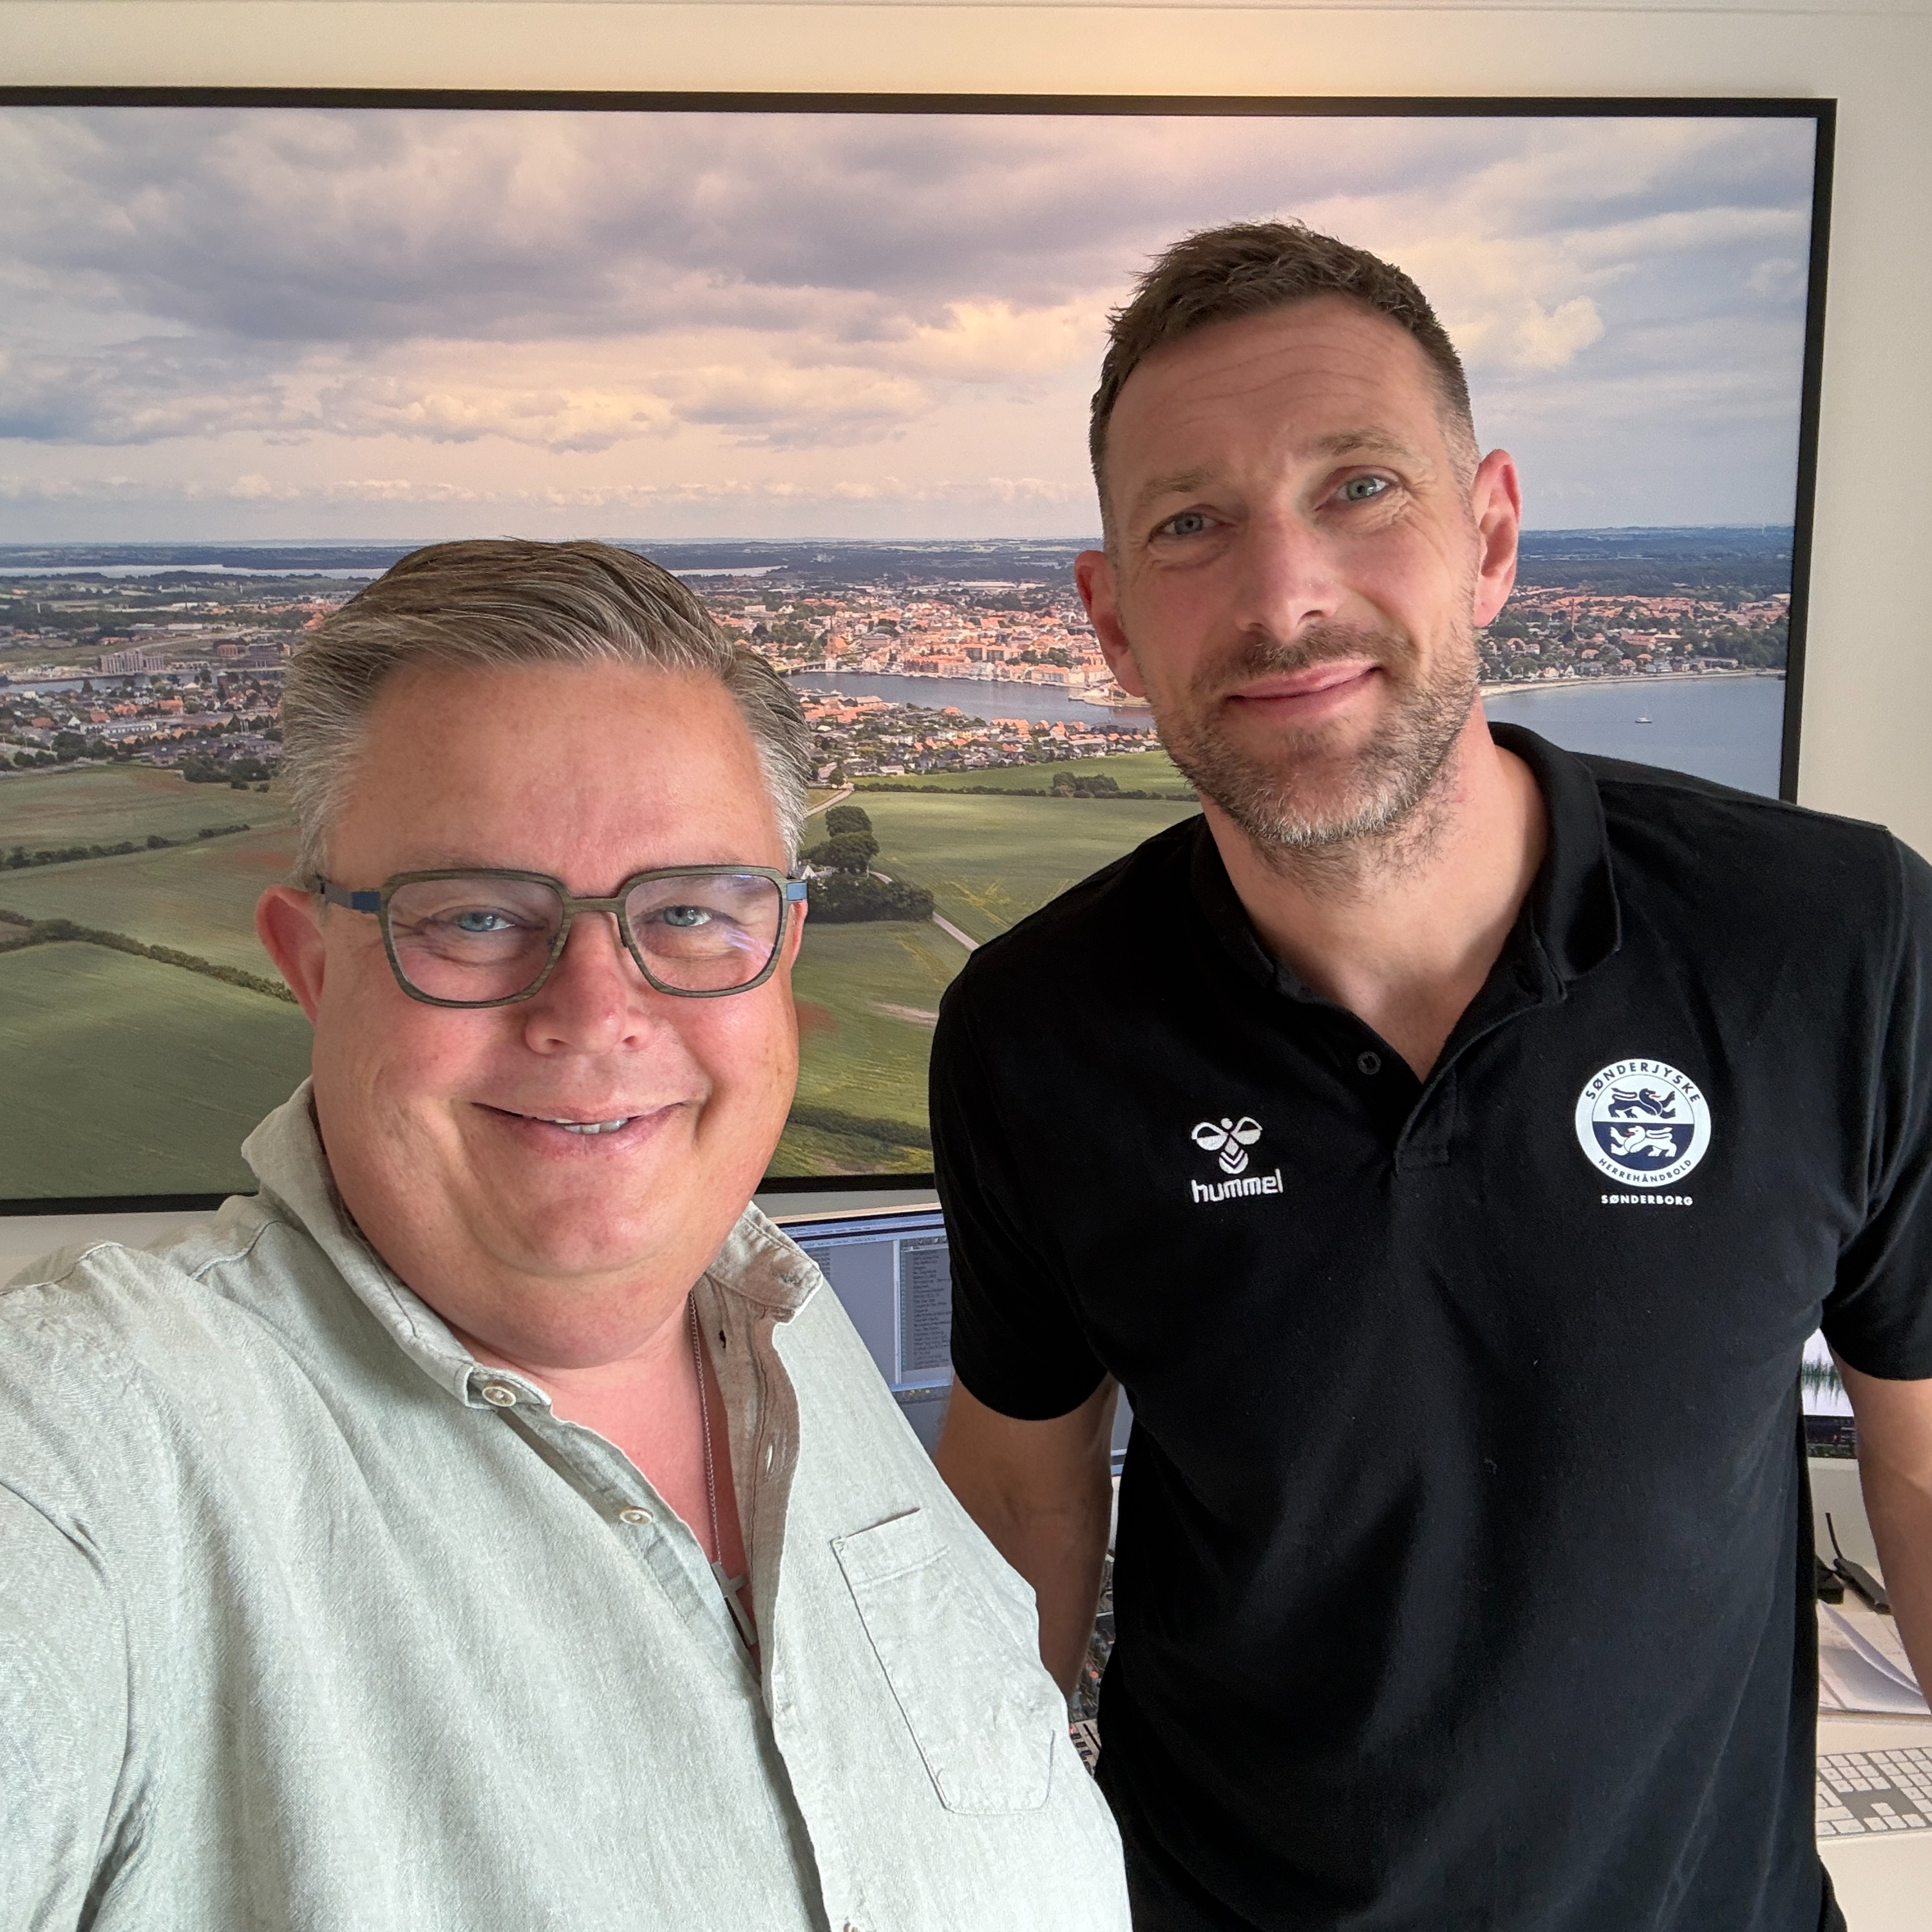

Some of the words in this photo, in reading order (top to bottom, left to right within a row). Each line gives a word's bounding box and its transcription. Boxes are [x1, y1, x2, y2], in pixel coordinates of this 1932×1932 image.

[1586, 1062, 1701, 1103] SØNDERJYSKE
[1191, 1168, 1283, 1203] hummel
[1598, 1158, 1692, 1183] HERREHÅNDBOLD
[1601, 1194, 1694, 1206] SØNDERBORG
